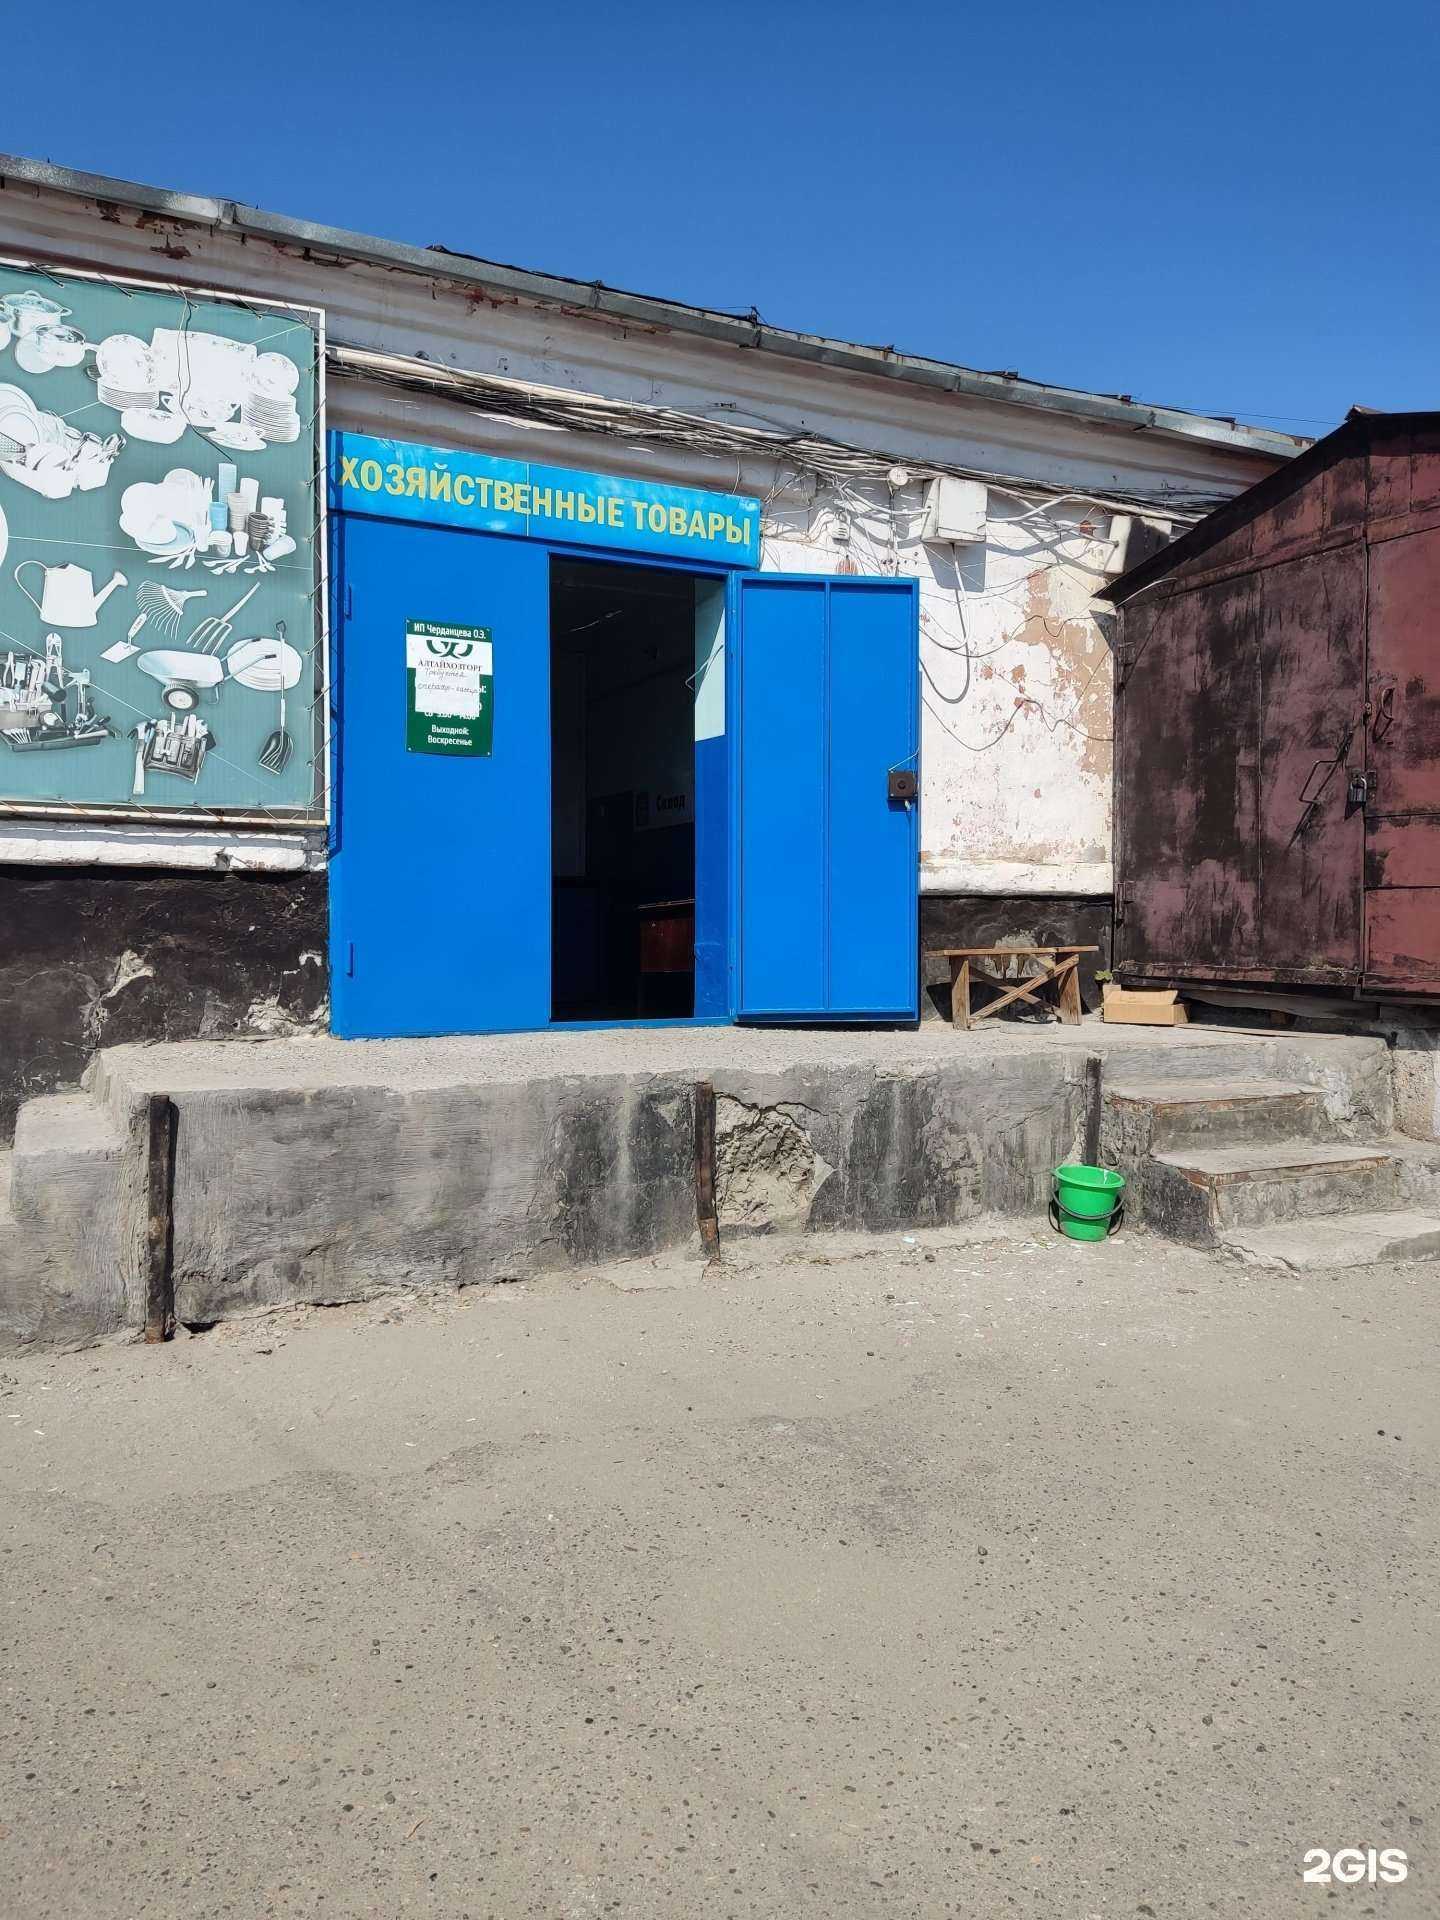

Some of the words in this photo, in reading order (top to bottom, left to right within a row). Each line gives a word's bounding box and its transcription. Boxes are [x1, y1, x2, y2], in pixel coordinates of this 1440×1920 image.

[339, 455, 624, 528] ХОЗЯЙСТВЕННЫЕ
[631, 500, 750, 545] ТОВАРЫ
[414, 622, 425, 632] ИП
[427, 624, 471, 638] Черданцева
[427, 734, 472, 746] Воскресенье
